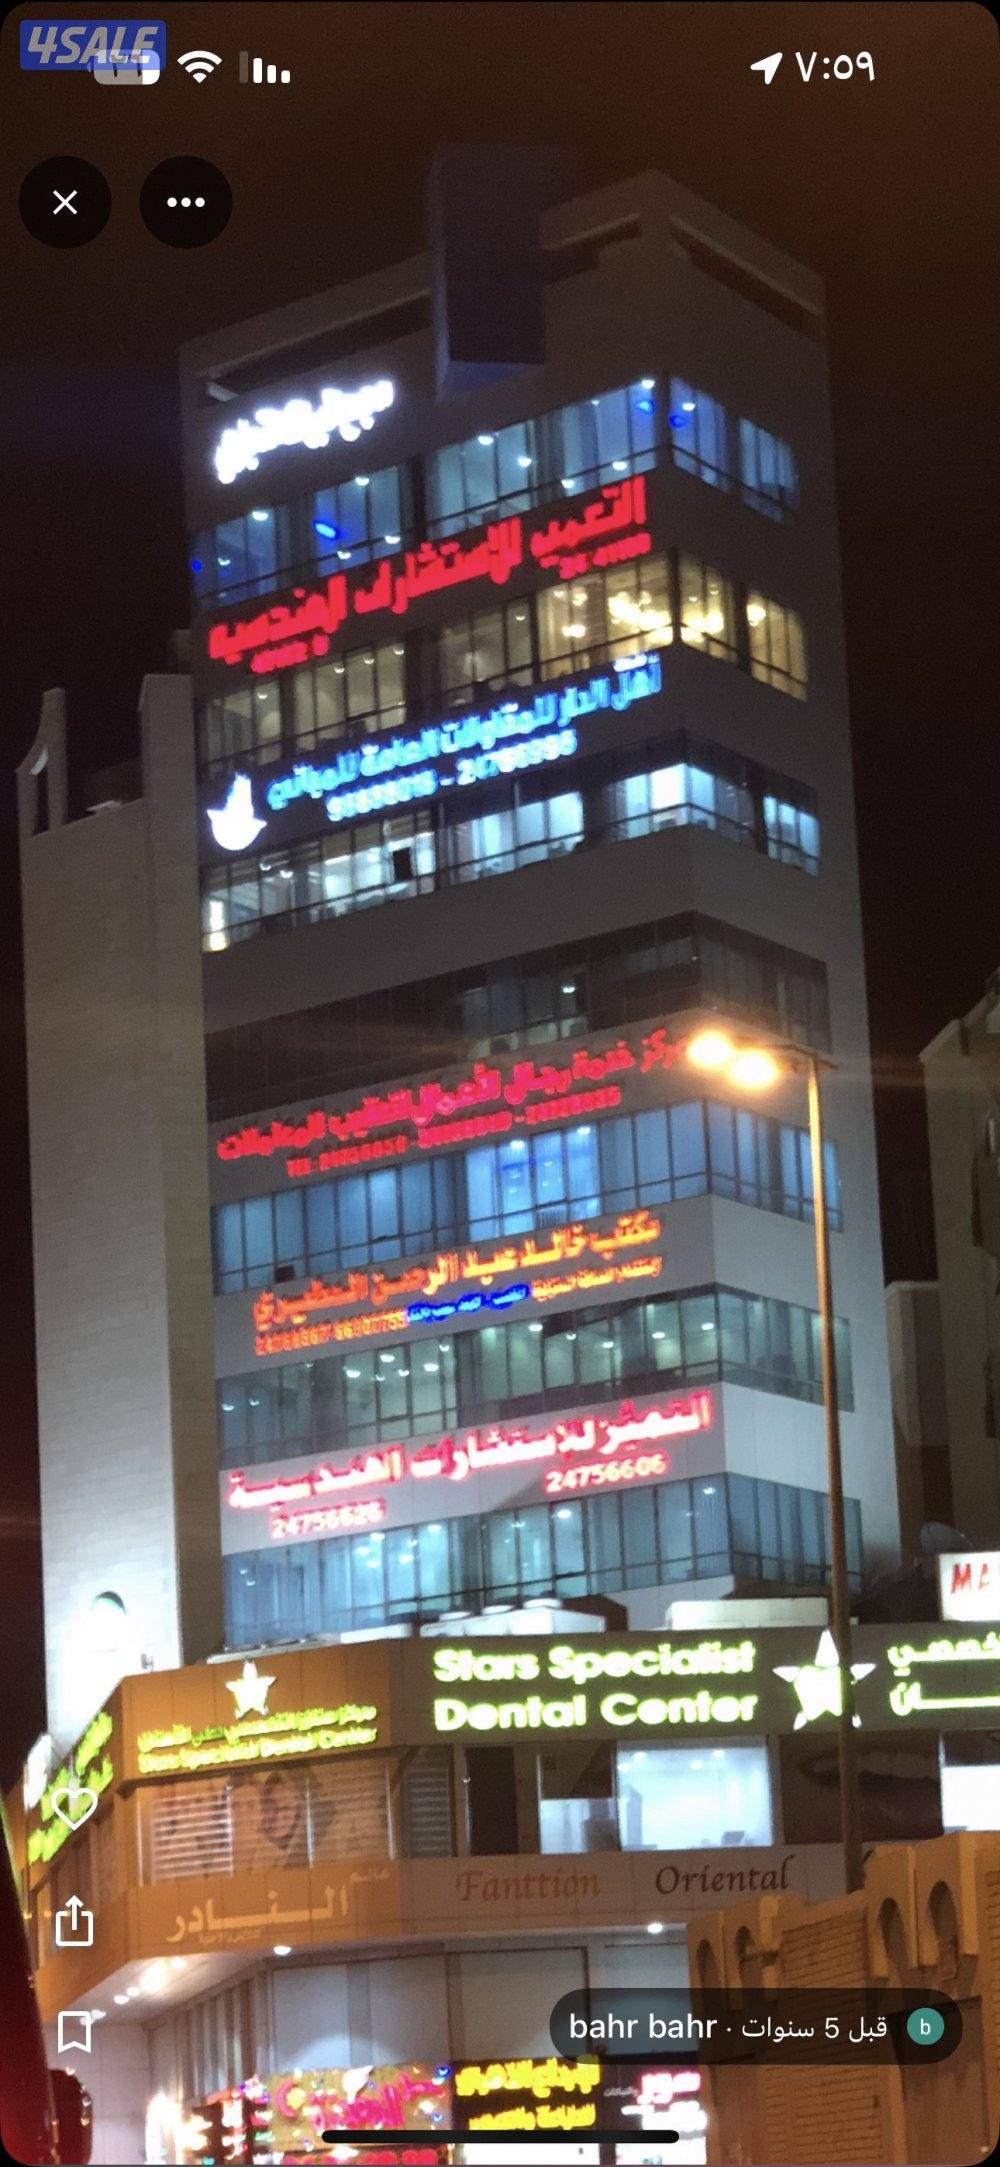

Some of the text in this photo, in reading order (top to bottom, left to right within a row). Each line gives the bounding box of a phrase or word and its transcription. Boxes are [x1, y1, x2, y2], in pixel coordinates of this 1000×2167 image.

[520, 1224, 588, 1267] خالد
[590, 1210, 661, 1260] مكتب
[370, 1251, 461, 1306] الرحمن
[462, 1246, 518, 1285] عبد
[433, 1640, 756, 1685] Stars Specialist
[433, 1691, 760, 1732] Dental Center
[655, 1855, 796, 1895] Oriental
[166, 1884, 349, 1942] النادر
